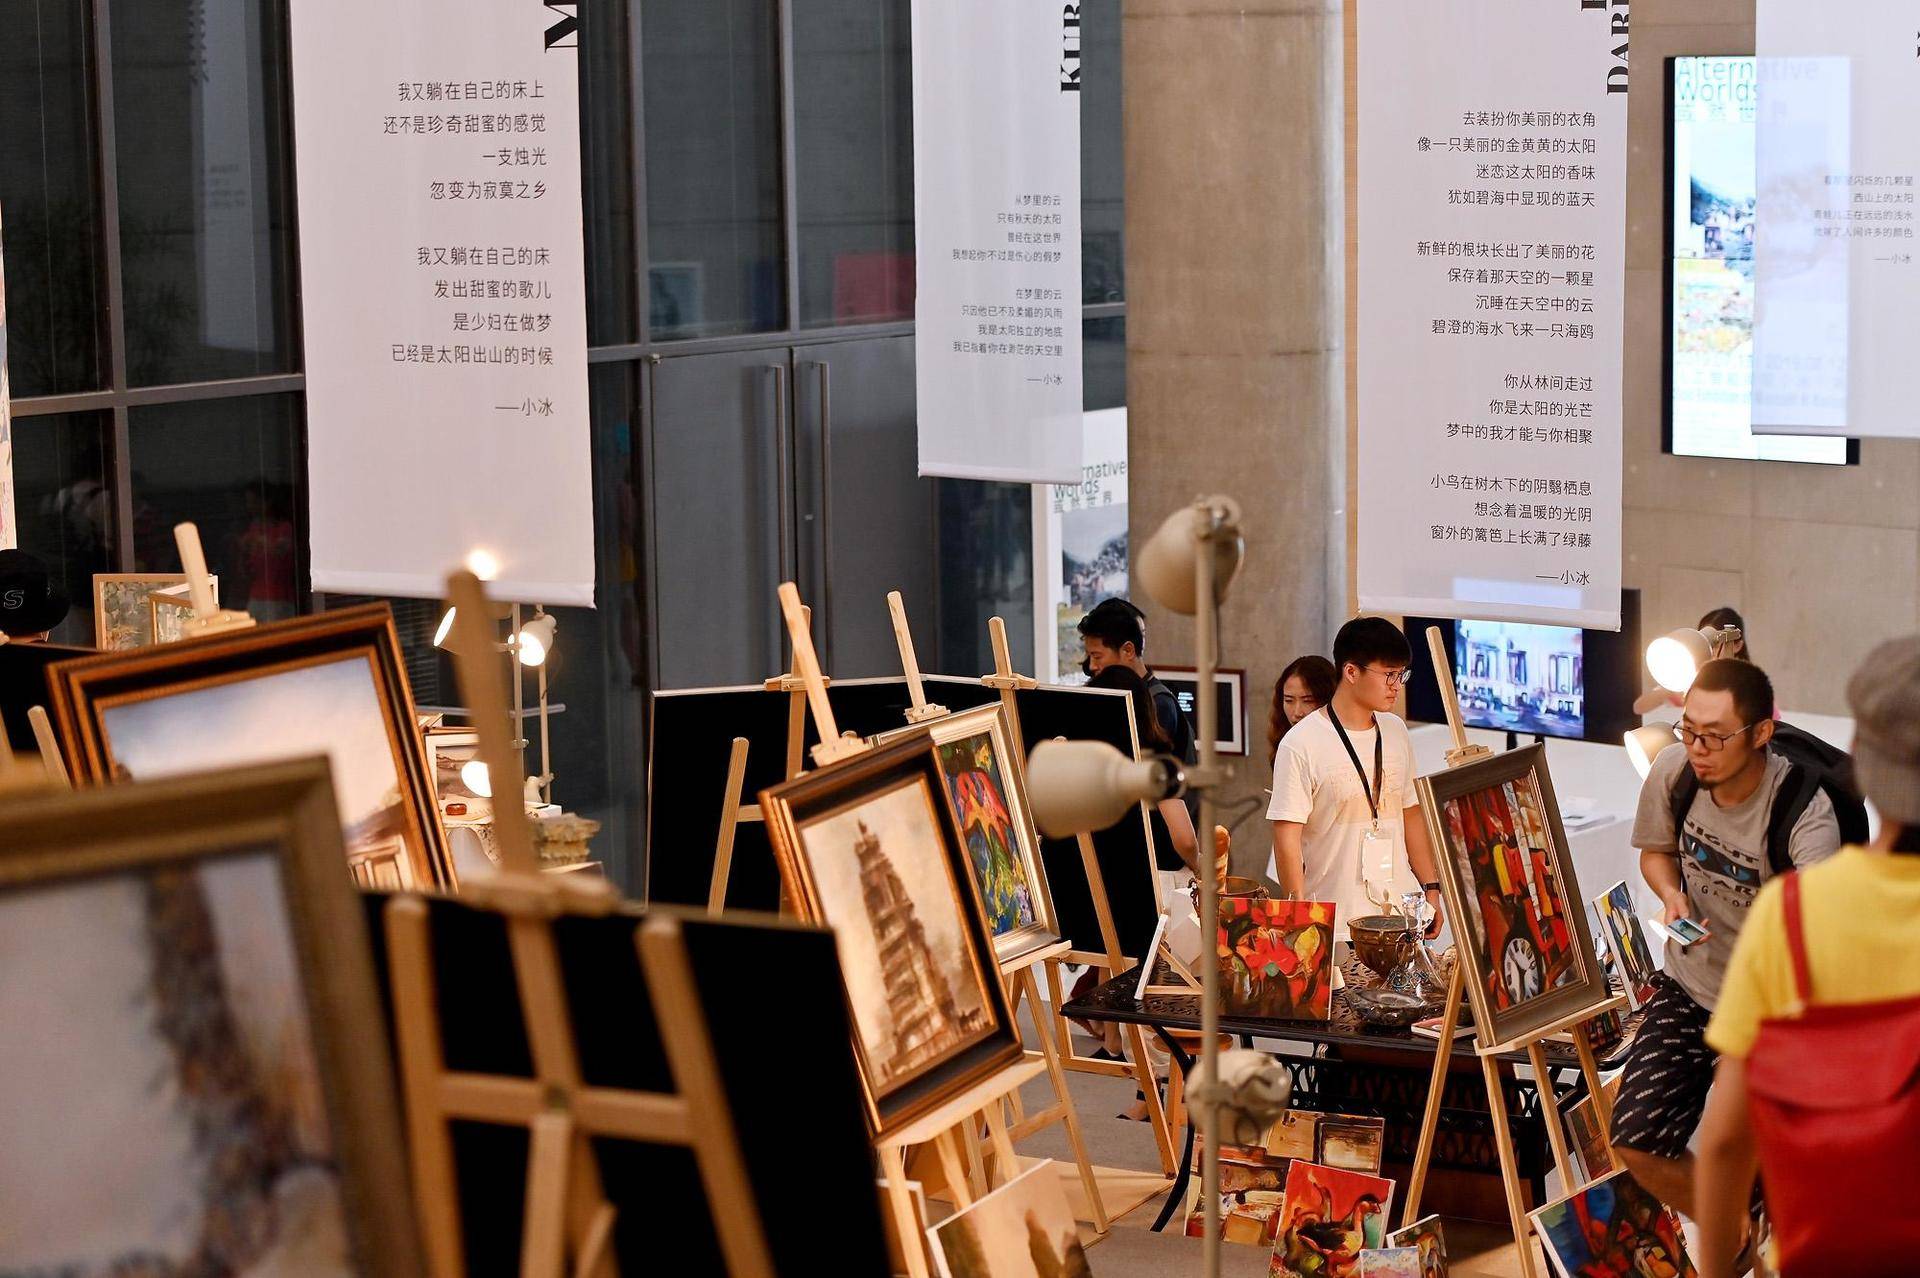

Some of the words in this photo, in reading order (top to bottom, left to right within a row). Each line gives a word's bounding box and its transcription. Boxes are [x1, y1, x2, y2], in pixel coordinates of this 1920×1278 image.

[398, 80, 544, 101] 我又躺在自己的床上
[384, 113, 546, 134] 还不是珍奇甜蜜的感觉
[1463, 110, 1595, 128] 去装扮你美丽的衣角
[1417, 137, 1595, 154] 像一只美丽的金黄黄的太阳
[482, 147, 547, 166] 一支烛光
[1476, 163, 1595, 181] 迷恋这太阳的香味
[430, 180, 546, 200] 忽变为寂寞之乡
[1448, 189, 1595, 207] 犹如碧海中显现的蓝天
[1016, 194, 1060, 206] 从梦里的云
[998, 213, 1061, 224] 只有秋天的太阳
[1008, 232, 1060, 243] 曾经在这世界
[418, 246, 550, 265] 我又躺在自己的床
[1417, 240, 1595, 260] 新鲜的根块长出了美丽的花
[1447, 268, 1594, 287] 保存着那天空的一颗星
[434, 280, 551, 299] 发出甜蜜的歌儿
[1016, 288, 1062, 300] 在梦里的云
[1475, 294, 1593, 312] 沉睡在天空中的云
[453, 312, 552, 332] 是少妇在做梦
[1432, 319, 1593, 340] 碧澄的海水飞来一只海鸥
[392, 344, 553, 365] 已经是太阳出山的时候
[1504, 374, 1593, 392] 你从林间走过
[1489, 399, 1593, 418] 你是太阳的光芒
[1447, 422, 1592, 444] 梦中的我才能与你相聚
[1475, 501, 1591, 522] 想念着温暖的光阴
[1431, 525, 1591, 548] 窗外的篱笆上长满了绿藤
